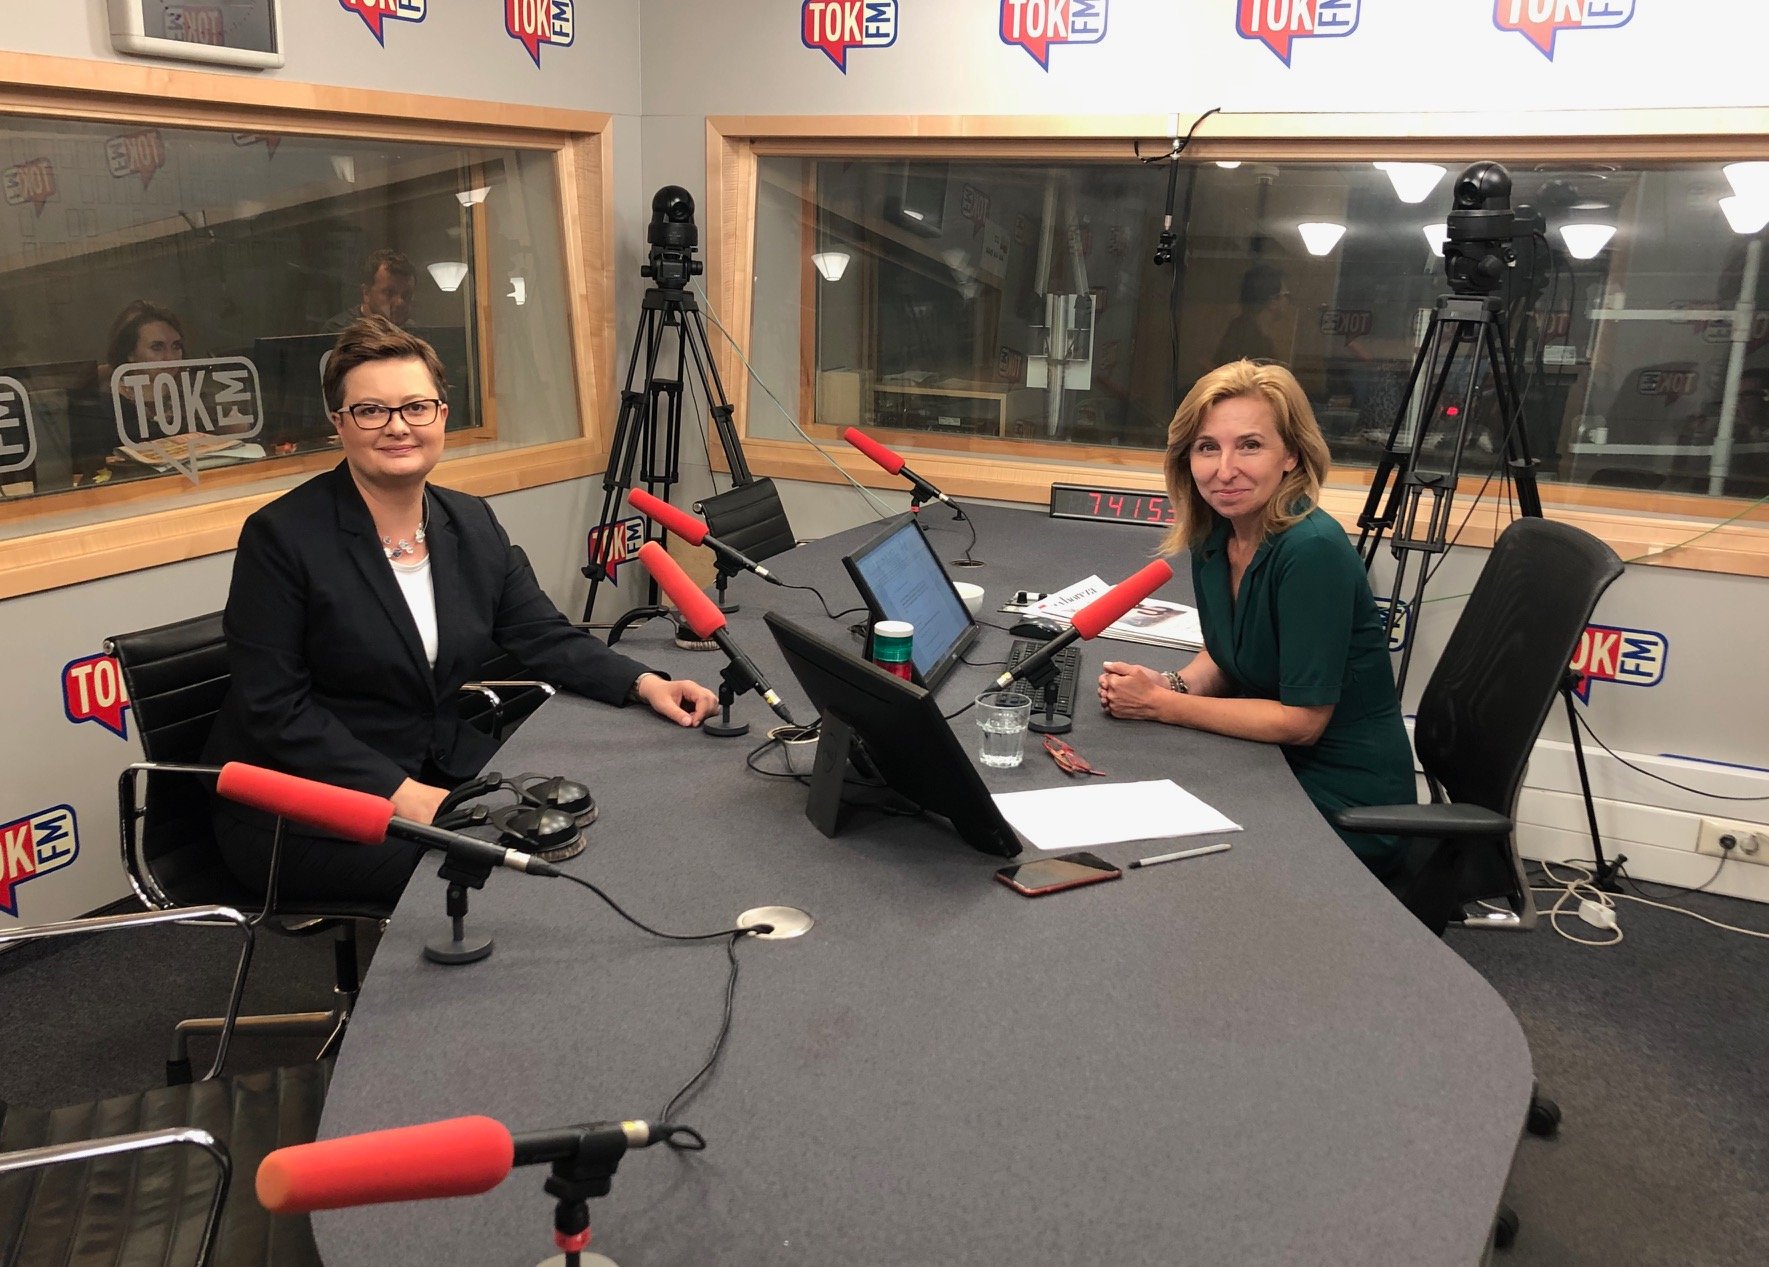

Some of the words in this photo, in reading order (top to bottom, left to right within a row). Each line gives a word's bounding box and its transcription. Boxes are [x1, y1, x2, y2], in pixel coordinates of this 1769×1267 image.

[552, 1, 570, 38] FM
[809, 2, 862, 42] TOK
[864, 3, 891, 38] FM
[1009, 0, 1068, 38] TOK
[1071, 0, 1099, 33] FM
[123, 370, 215, 439] TOK
[213, 370, 254, 427] FM
[626, 522, 642, 554] FM
[1619, 637, 1659, 678] FM
[34, 813, 71, 865] FM
